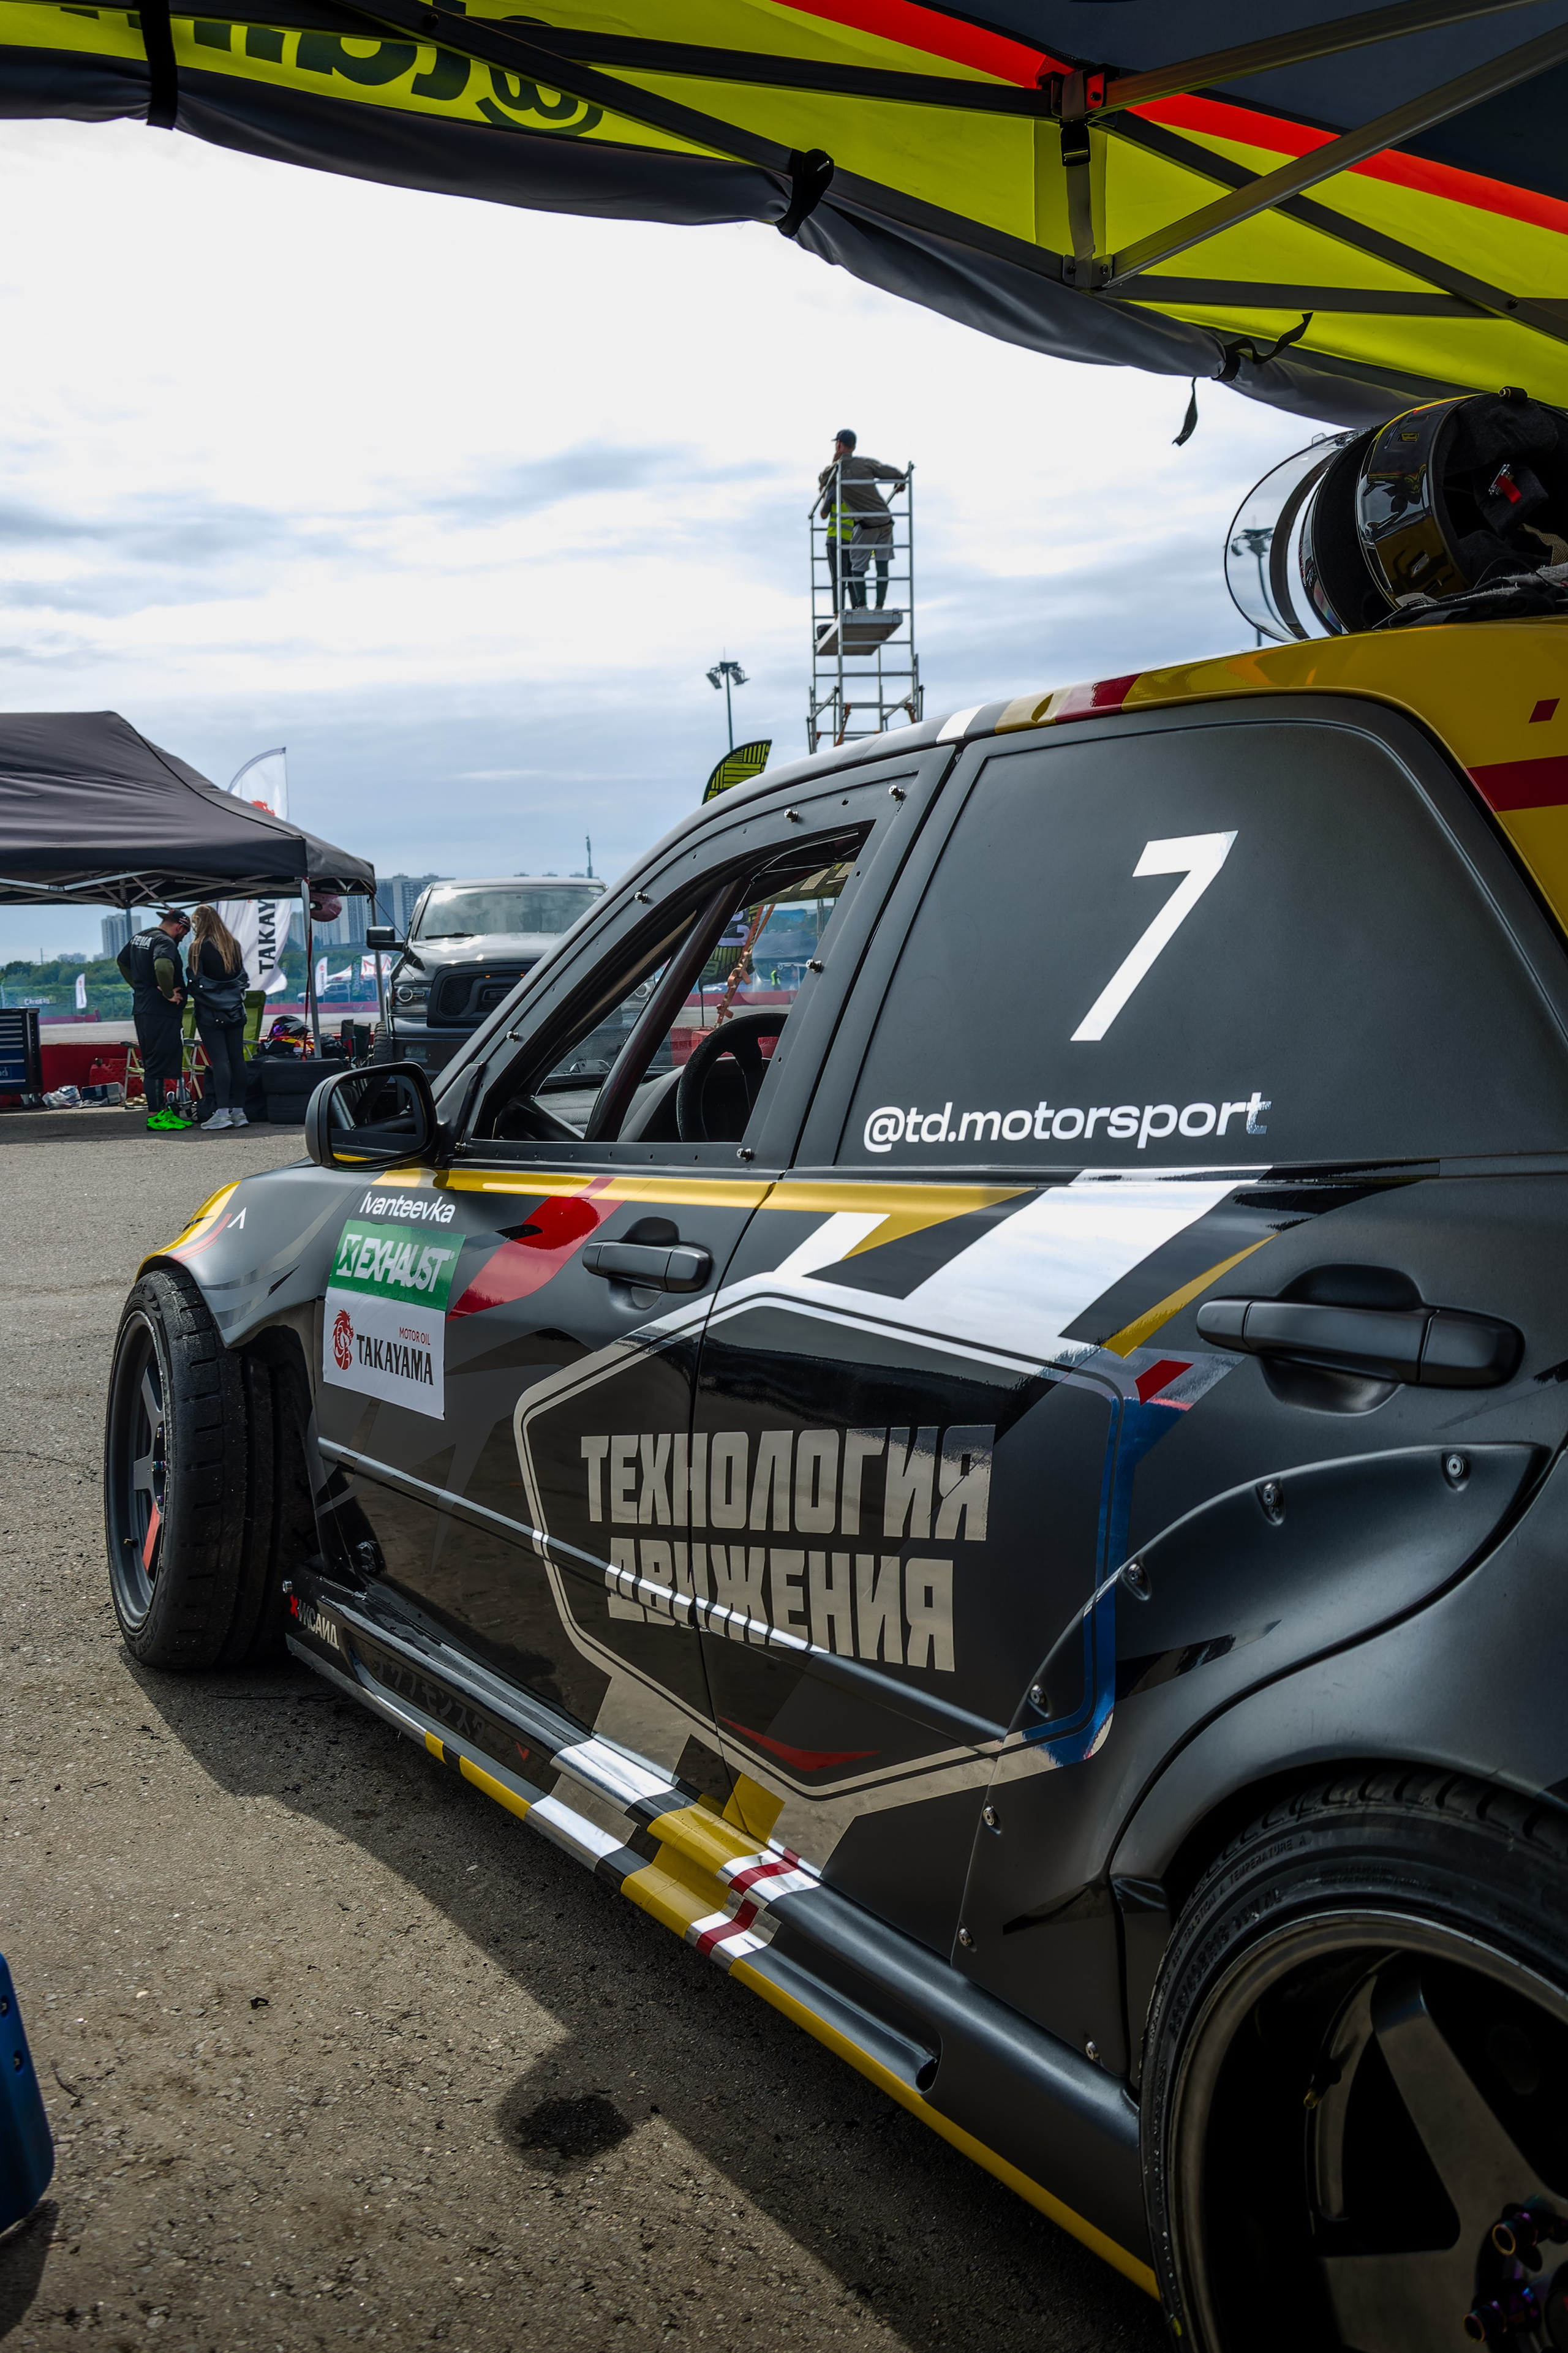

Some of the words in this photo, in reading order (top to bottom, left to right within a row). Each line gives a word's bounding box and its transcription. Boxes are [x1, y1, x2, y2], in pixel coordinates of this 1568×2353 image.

[1071, 830, 1238, 1041] 7
[864, 1093, 1272, 1153] @td.motorsport
[359, 1192, 456, 1224] Ivanteevka
[356, 1334, 434, 1386] TAKAYAMA
[399, 1327, 421, 1342] MOTOR
[421, 1333, 431, 1346] OIL
[581, 1425, 996, 1542] ТЕХНОЛОГИЯ
[605, 1537, 956, 1673] ДВИЖЕНИЯ
[1230, 1839, 1292, 1885] TEMPERATURE
